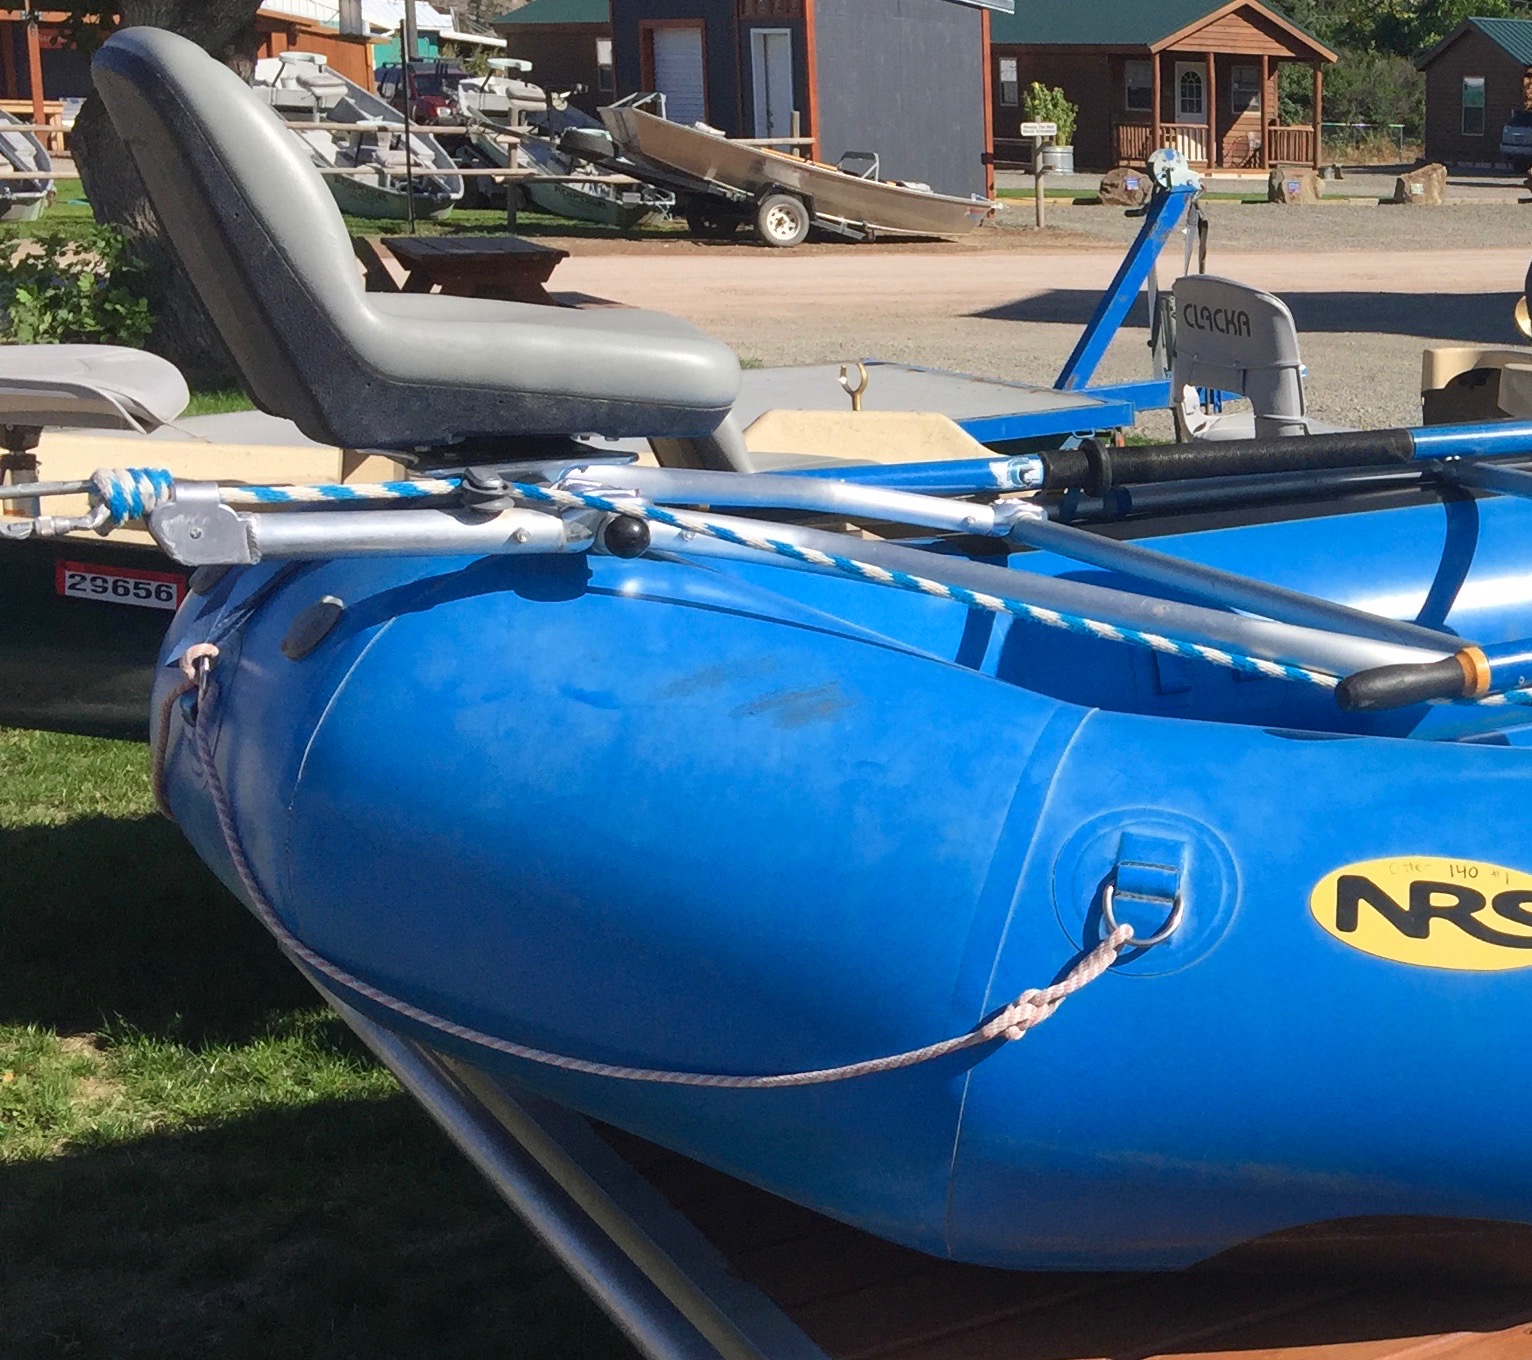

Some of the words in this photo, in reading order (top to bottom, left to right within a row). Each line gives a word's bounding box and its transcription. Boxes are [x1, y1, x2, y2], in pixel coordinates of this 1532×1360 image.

[1183, 303, 1251, 337] CLACKA
[67, 573, 173, 602] 29656
[1449, 864, 1478, 878] 140
